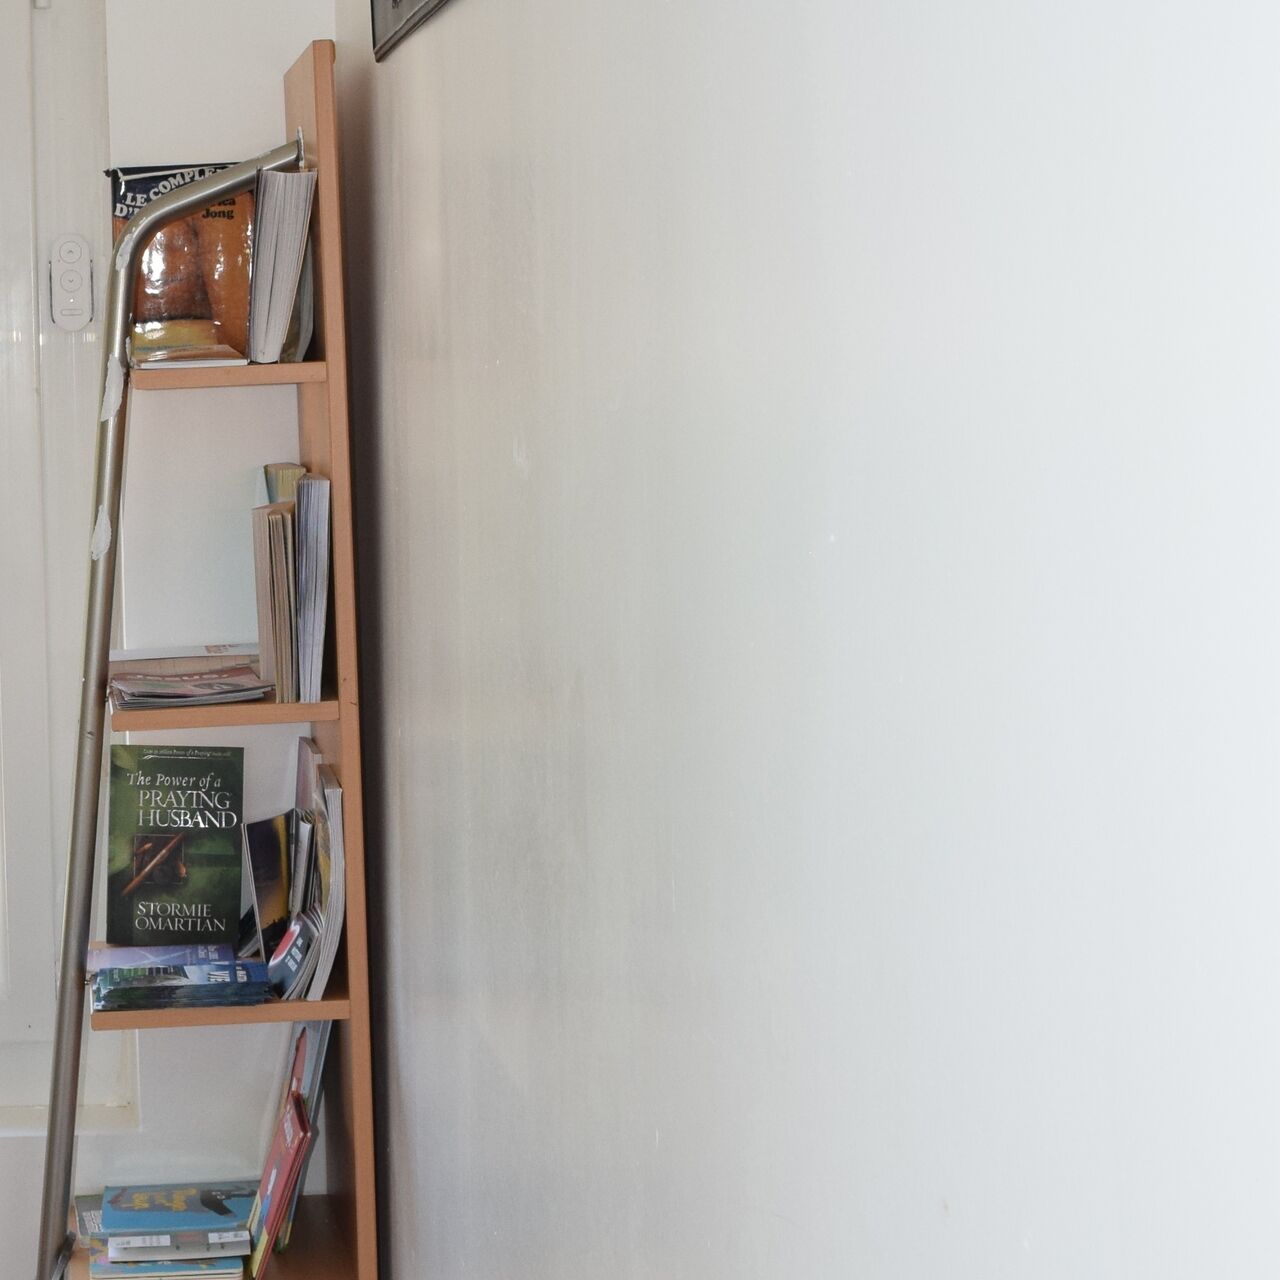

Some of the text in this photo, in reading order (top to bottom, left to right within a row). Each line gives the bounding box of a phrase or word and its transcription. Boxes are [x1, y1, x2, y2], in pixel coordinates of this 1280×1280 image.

[124, 167, 220, 207] LE COMPLE
[202, 208, 235, 220] Jong
[127, 770, 221, 791] The Power of a
[138, 789, 231, 809] PRAYING
[138, 809, 238, 828] HUSBAND
[137, 901, 212, 917] STORMIE
[135, 916, 226, 931] OMARTIAN
